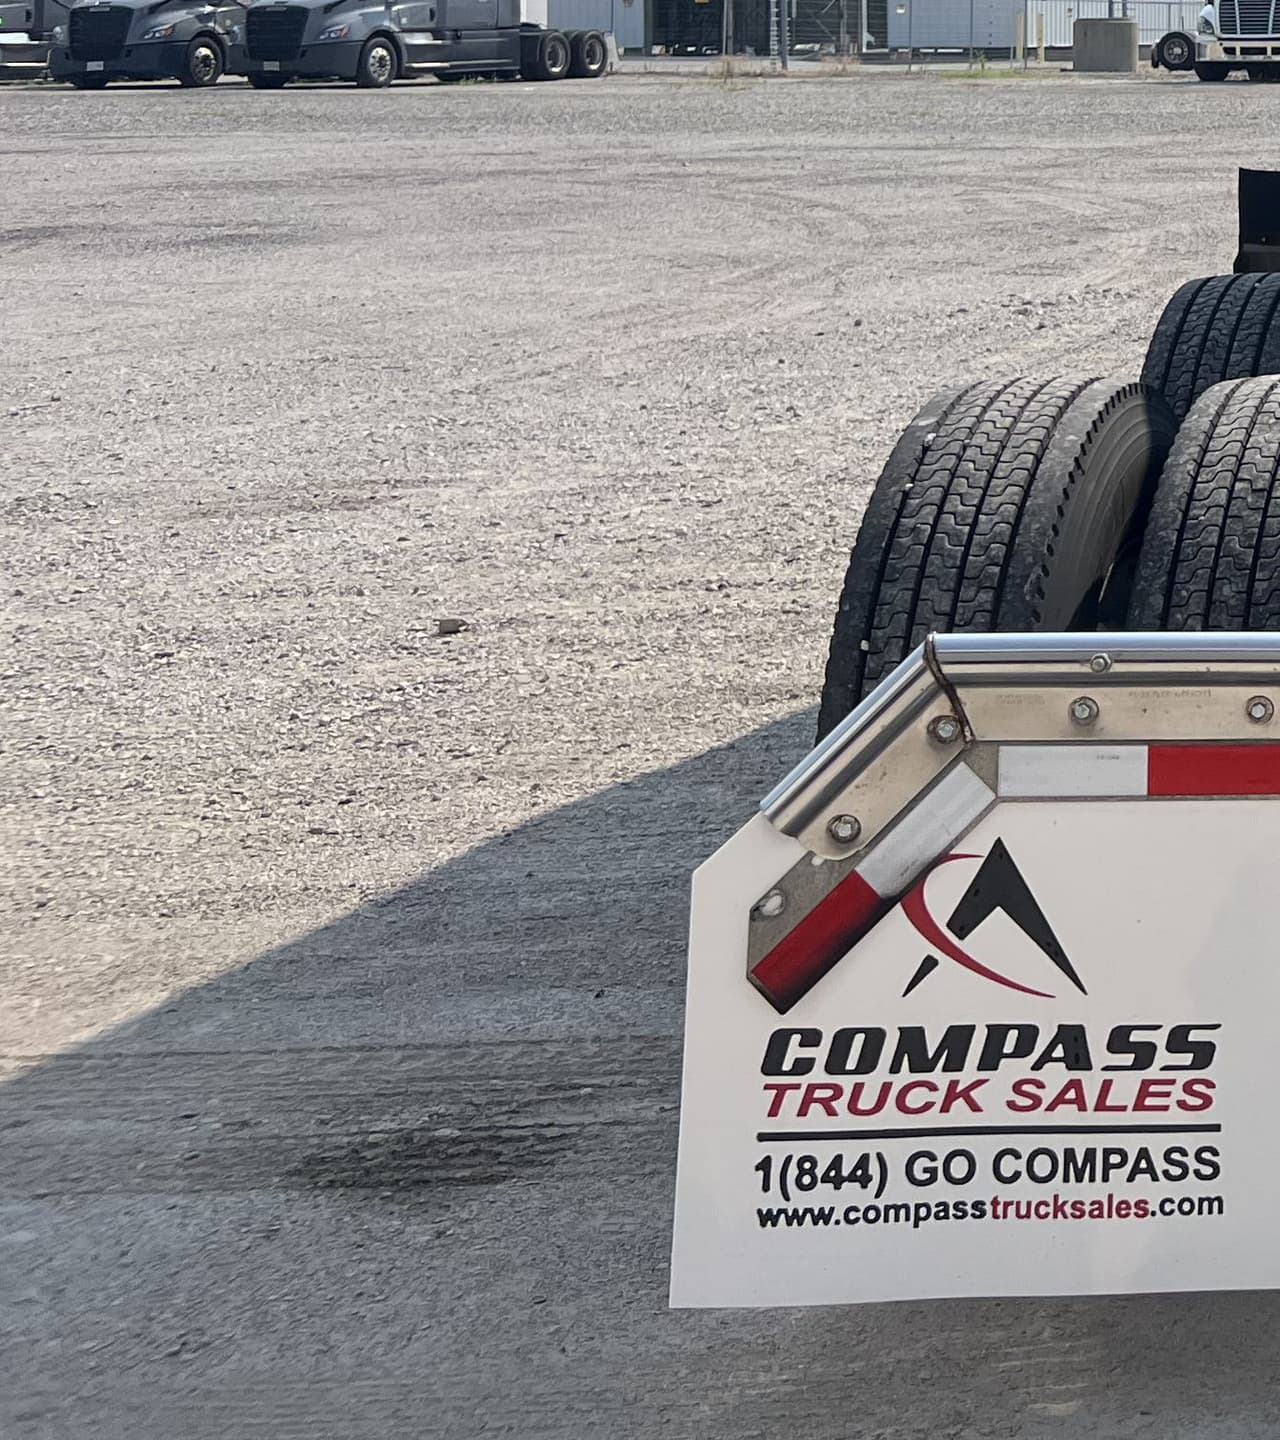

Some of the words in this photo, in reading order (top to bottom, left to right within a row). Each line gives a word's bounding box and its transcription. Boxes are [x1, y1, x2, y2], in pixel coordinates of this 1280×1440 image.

[760, 1022, 1222, 1076] COMPASS
[762, 1078, 990, 1118] TRUCK
[1005, 1077, 1217, 1113] SALES
[754, 1152, 889, 1201] 1(844)
[904, 1148, 977, 1188] GO
[991, 1145, 1221, 1185] COMPASS
[756, 1192, 1225, 1229] www.compasstrucksales.com
